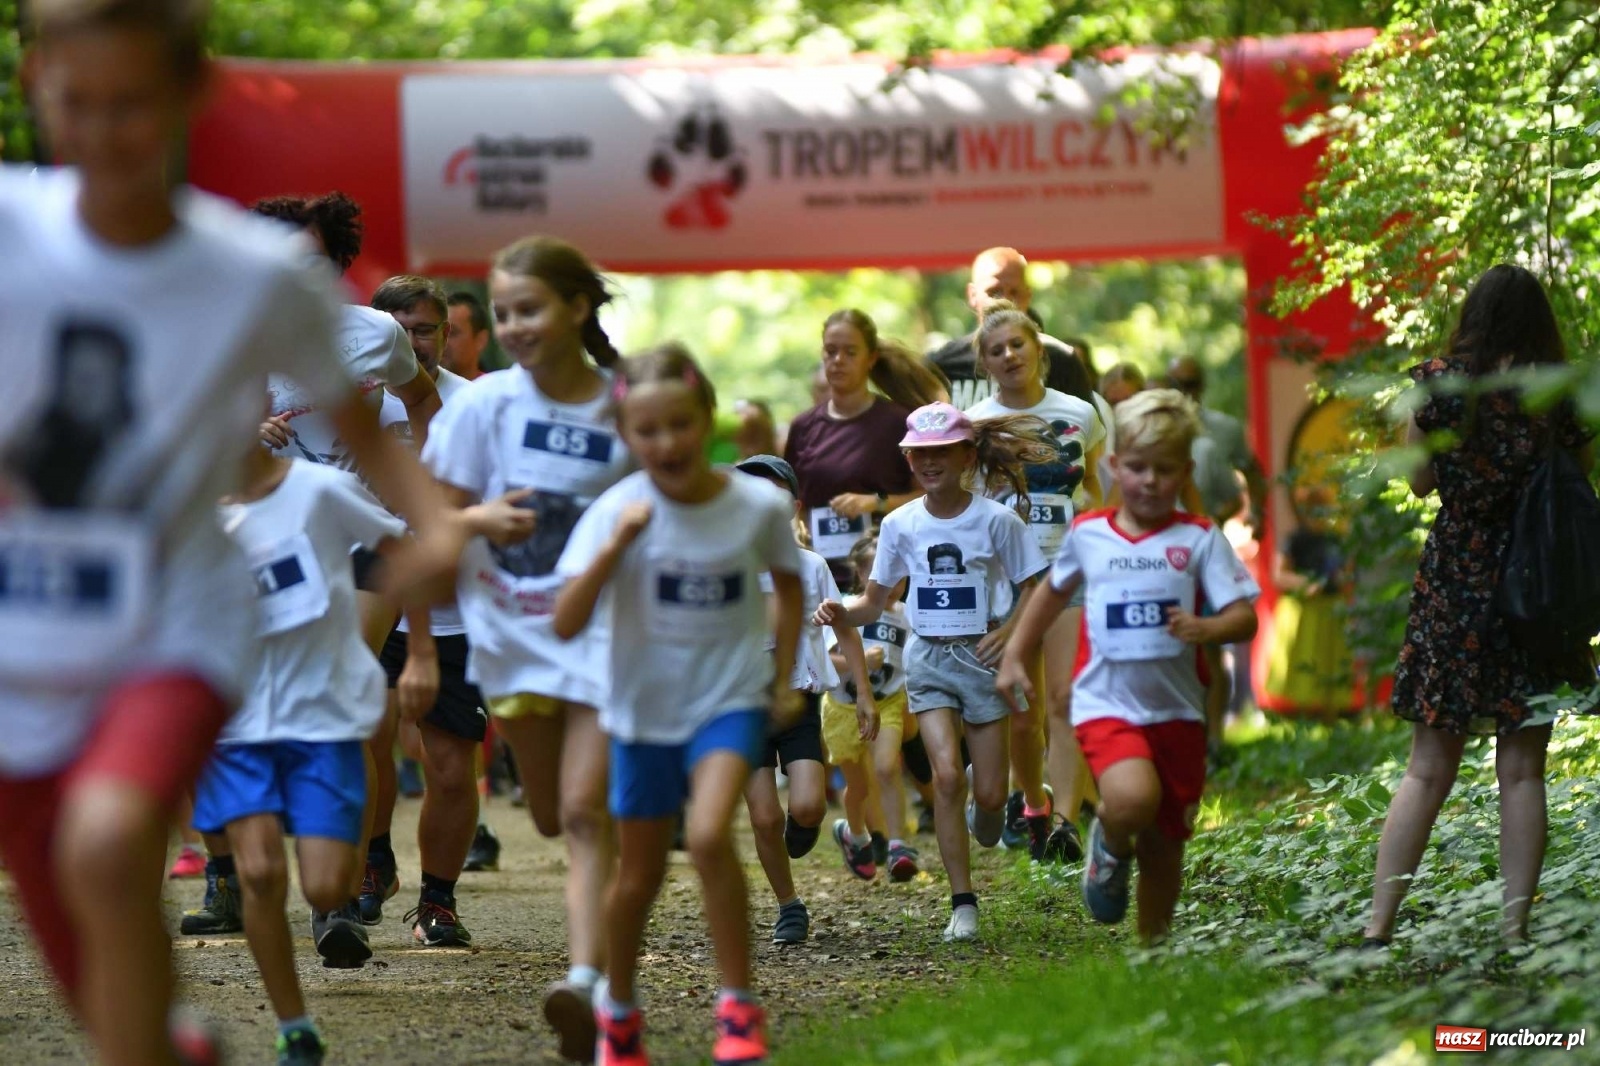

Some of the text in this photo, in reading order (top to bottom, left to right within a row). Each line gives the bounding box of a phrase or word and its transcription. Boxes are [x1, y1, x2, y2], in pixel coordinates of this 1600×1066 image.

[545, 426, 590, 455] 65
[828, 518, 849, 532] 95
[1109, 557, 1168, 570] POLSKA
[936, 590, 950, 607] 3
[1123, 603, 1161, 626] 68
[876, 624, 897, 642] 66
